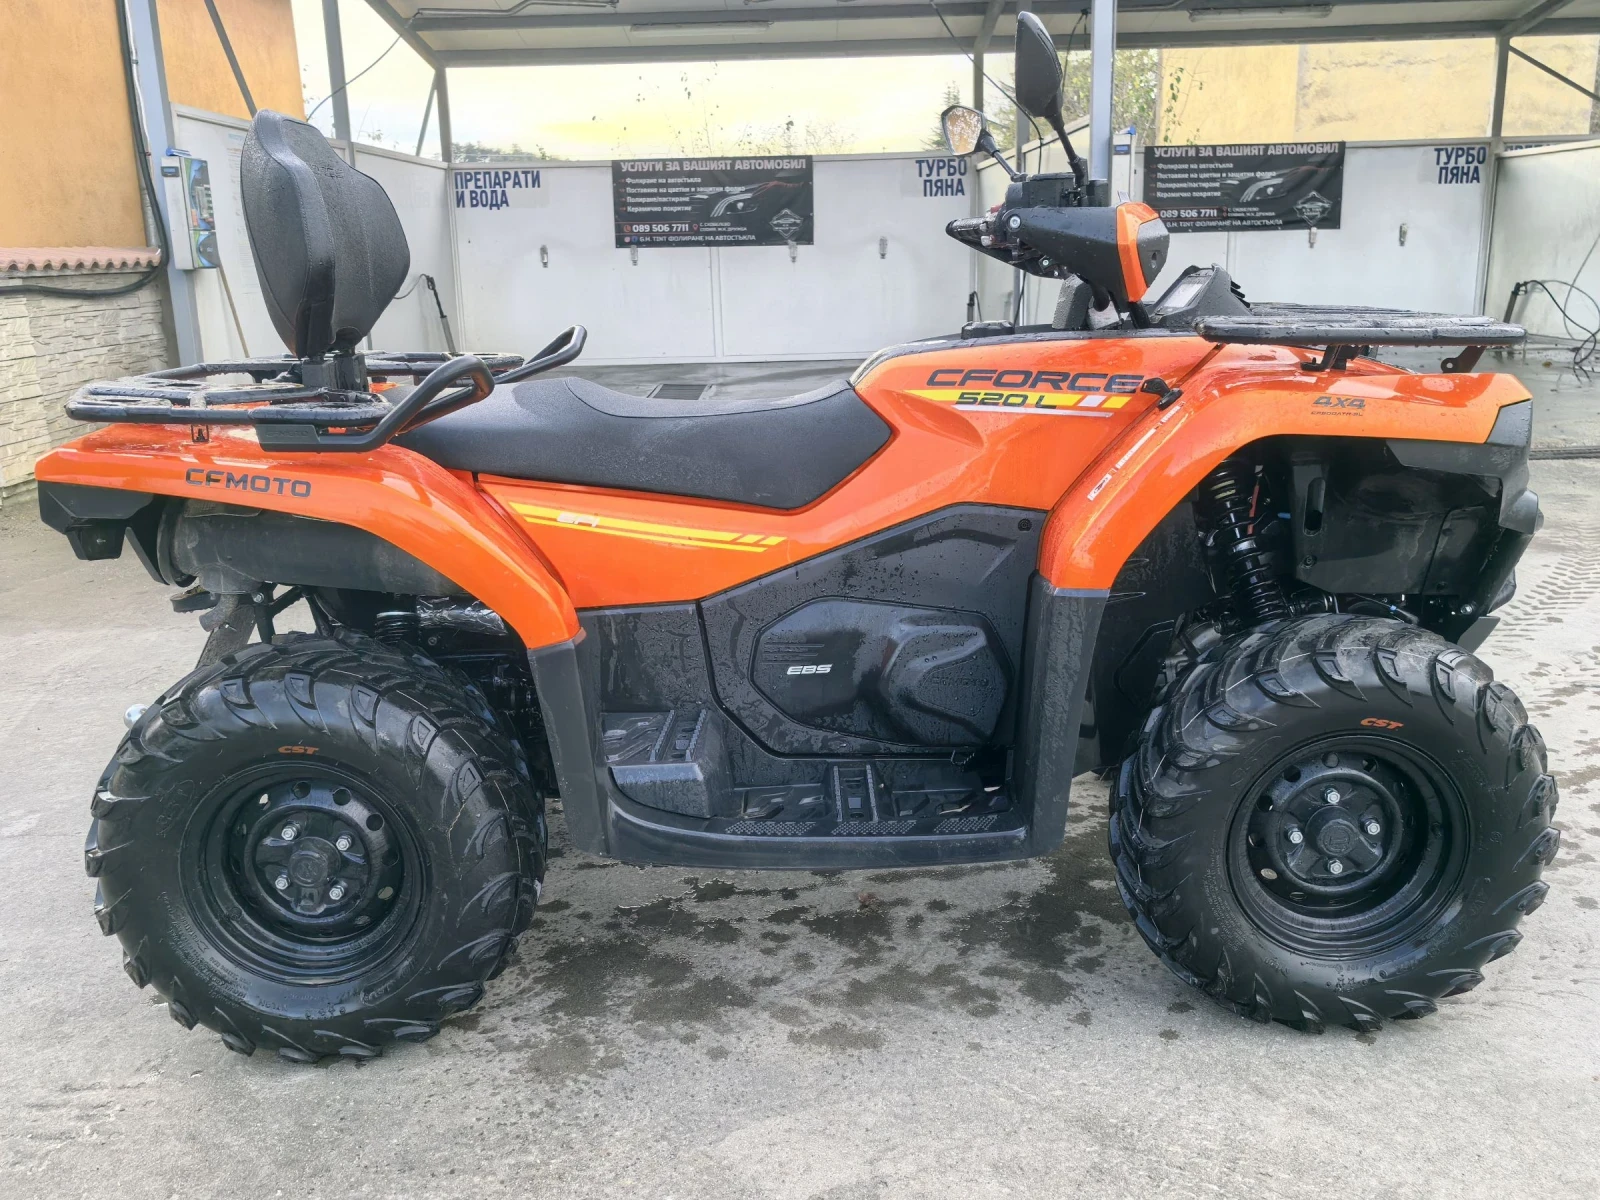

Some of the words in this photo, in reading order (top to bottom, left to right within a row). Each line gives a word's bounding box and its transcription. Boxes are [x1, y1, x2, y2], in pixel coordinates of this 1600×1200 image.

[1154, 147, 1196, 157] УСЛУГИ
[1198, 146, 1213, 157] ЗА
[1215, 145, 1265, 156] ВАШИЯТ
[1267, 143, 1339, 155] АВТОМОБИЛ
[1434, 147, 1487, 165] ТУРБО
[620, 161, 663, 172] УСЛУГИ
[665, 161, 680, 171] ЗА
[683, 160, 732, 171] ВАШИЯТ
[734, 159, 806, 170] АВТОМОБИЛ
[915, 158, 967, 177] ТУРБО
[454, 170, 541, 189] ПРЕПАРАТИ
[1438, 166, 1480, 184] ПЯНА
[923, 178, 965, 197] ПЯНА
[456, 190, 465, 208] И
[469, 189, 510, 210] ВОДА
[1160, 210, 1178, 218] 089
[1180, 210, 1198, 218] 506
[1199, 209, 1217, 217] 7711
[632, 224, 650, 232] 089
[652, 224, 670, 232] 506
[671, 224, 689, 232] 7711
[926, 369, 1145, 394] CFORCE
[955, 392, 1028, 407] 520
[1036, 394, 1058, 410] L
[185, 467, 312, 498] CFMOTO
[1360, 717, 1404, 730] CST
[277, 745, 320, 755] CST
